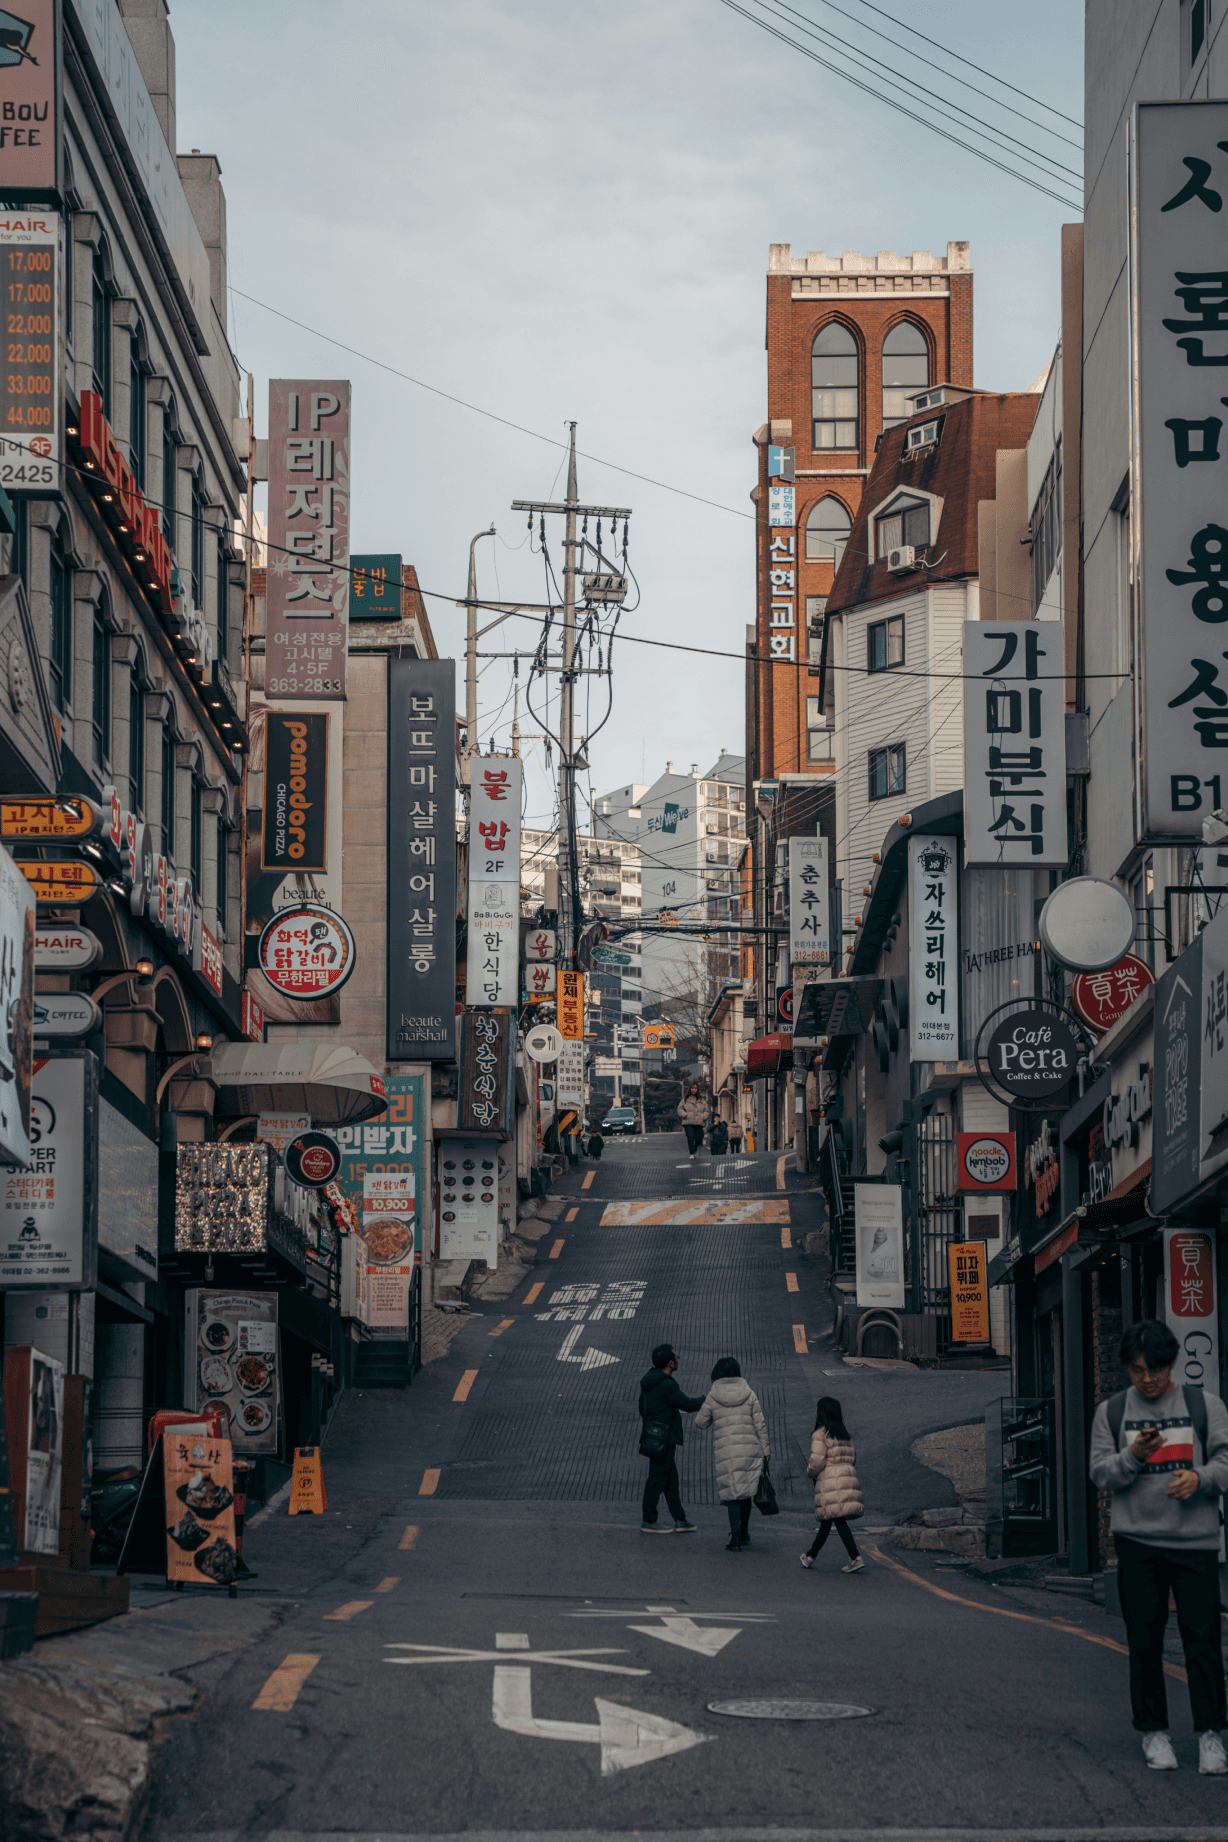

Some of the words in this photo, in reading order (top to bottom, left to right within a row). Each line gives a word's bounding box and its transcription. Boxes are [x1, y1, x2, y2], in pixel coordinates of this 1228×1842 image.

[8, 252, 50, 271] 17,000
[8, 284, 50, 303] 17,000
[8, 315, 50, 334] 22,000
[8, 344, 50, 363] 22,000
[8, 375, 50, 395] 33,000
[8, 407, 50, 427] 44,000
[32, 441, 49, 455] 3F
[769, 536, 795, 662] 신현교회
[274, 632, 343, 645] 여성전용
[284, 647, 332, 661] 고시텔
[983, 630, 1047, 855] 가미분식
[281, 720, 314, 859] pomodoro
[276, 783, 286, 826] CHICAGO
[275, 829, 286, 856] PIZZA
[485, 861, 504, 872] 2F
[662, 881, 675, 897] 104
[800, 866, 821, 936] 춘추사
[277, 929, 308, 943] 화덕
[795, 951, 828, 960] 312-6661
[924, 883, 946, 1014] 자쓰리헤어
[274, 949, 326, 968] 닭갈비
[483, 932, 503, 1002] 한식당
[966, 944, 1014, 974] JATHREE
[276, 970, 329, 986] 무한리필
[1085, 966, 1142, 1010] 貢茶
[401, 1013, 442, 1027] beauté
[922, 1022, 950, 1030] 이대본점
[397, 1029, 447, 1041] marshall
[918, 1032, 954, 1041] 312-6677
[663, 1048, 677, 1064] 104
[998, 1043, 1068, 1070] Pera
[1165, 1033, 1188, 1091] POPO
[472, 1016, 499, 1126] 청춘식당
[1007, 1072, 1031, 1080] Coffee
[1033, 1072, 1041, 1080] &
[1042, 1071, 1062, 1080] Cake
[1165, 1077, 1188, 1136] TREE
[30, 1148, 56, 1160] PER
[972, 1147, 1005, 1157] noodle
[179, 1150, 263, 1185] CHICAGO
[970, 1156, 1006, 1168] kimbob
[6, 1178, 55, 1188] 스터디카페
[190, 1192, 250, 1215] PIZZA
[372, 1199, 408, 1211] 10,900
[209, 1222, 251, 1244] PUB
[956, 1256, 979, 1270] 피자
[957, 1271, 979, 1285] 뷔페
[1176, 1238, 1204, 1312] 貢茶
[956, 1293, 982, 1303] 10,900
[1184, 1331, 1212, 1396] Go
